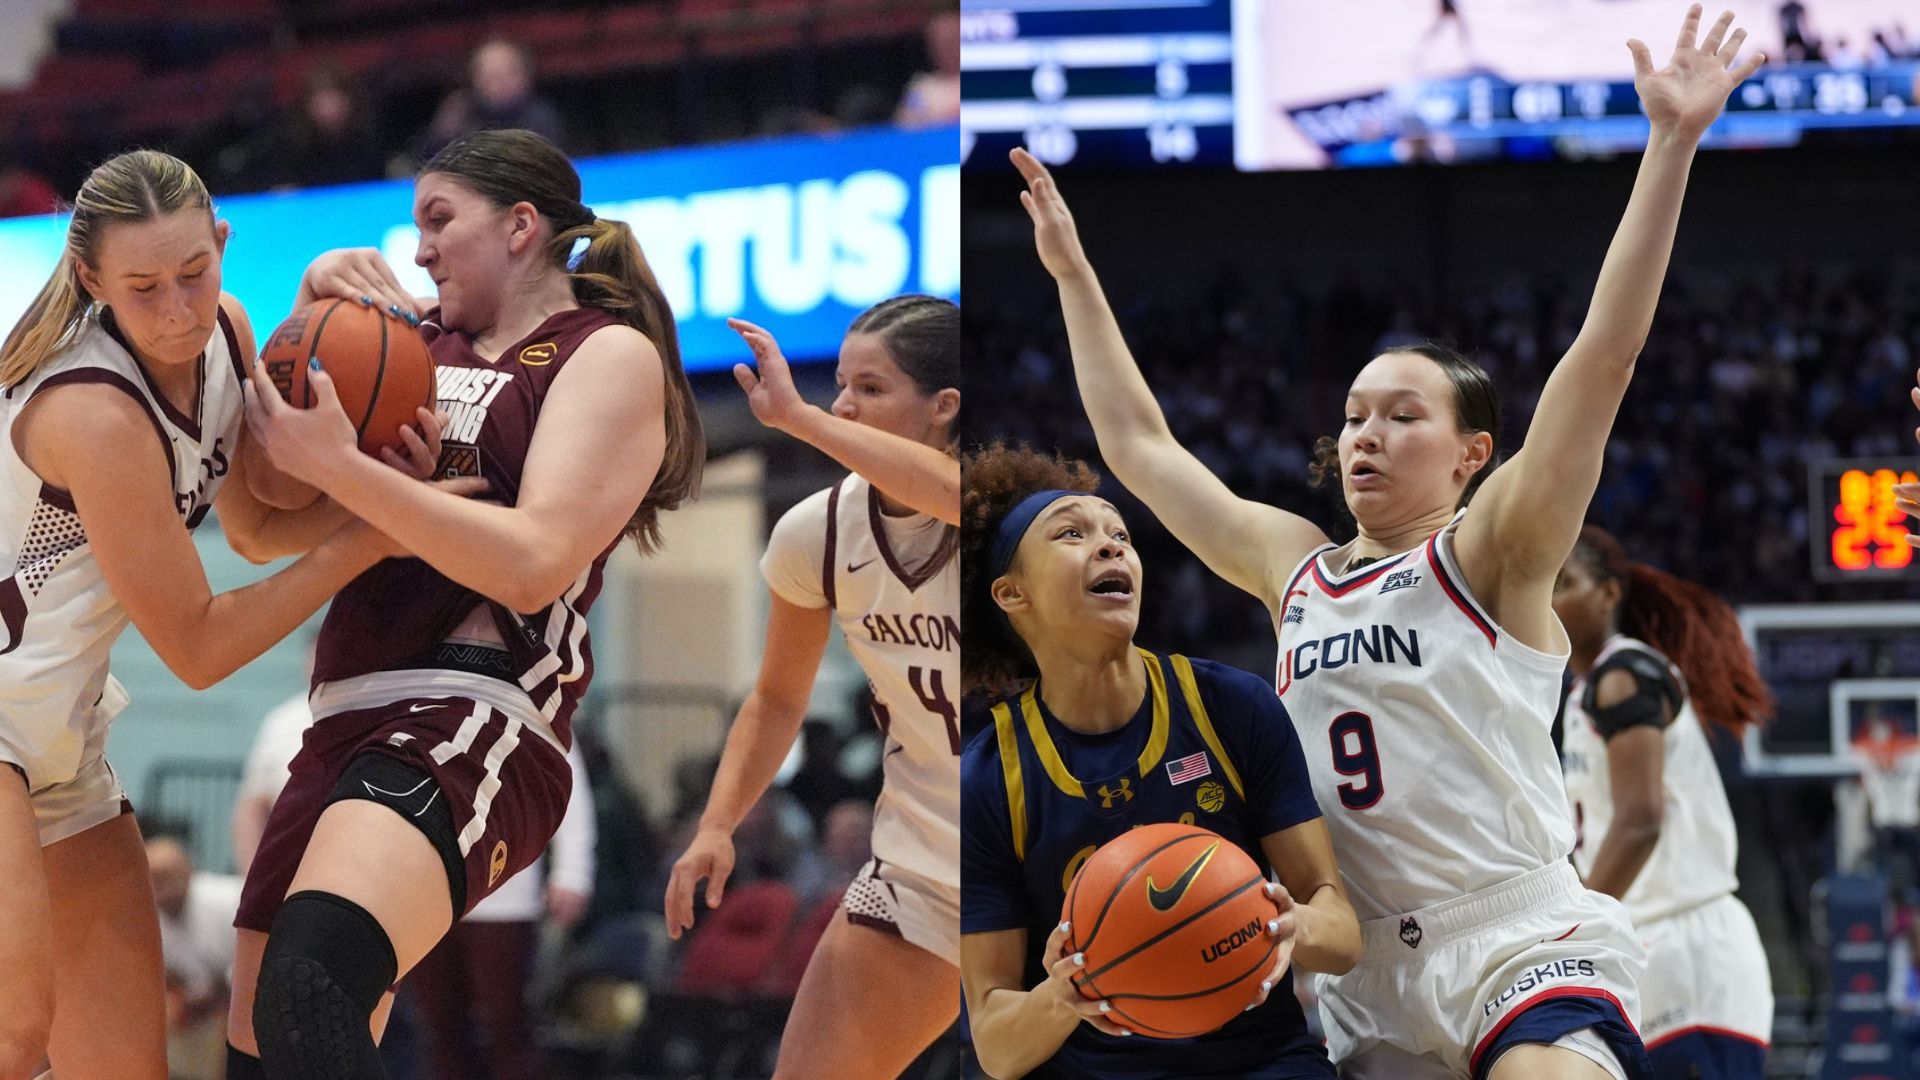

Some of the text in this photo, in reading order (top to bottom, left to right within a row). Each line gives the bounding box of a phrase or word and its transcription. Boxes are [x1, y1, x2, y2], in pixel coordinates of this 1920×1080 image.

[593, 168, 909, 322] RTUS
[436, 365, 515, 408] HRIST
[437, 400, 487, 445] ING
[1381, 576, 1422, 591] EAST
[1386, 568, 1414, 582] BIG
[1288, 605, 1306, 616] THE
[526, 626, 538, 642] XL
[437, 645, 513, 672] NIK
[1277, 624, 1422, 697] UCONN
[908, 665, 960, 756] 4
[1328, 711, 1385, 811] 9
[1200, 916, 1263, 964] UCONN
[1483, 958, 1597, 1017] HUSKIES
